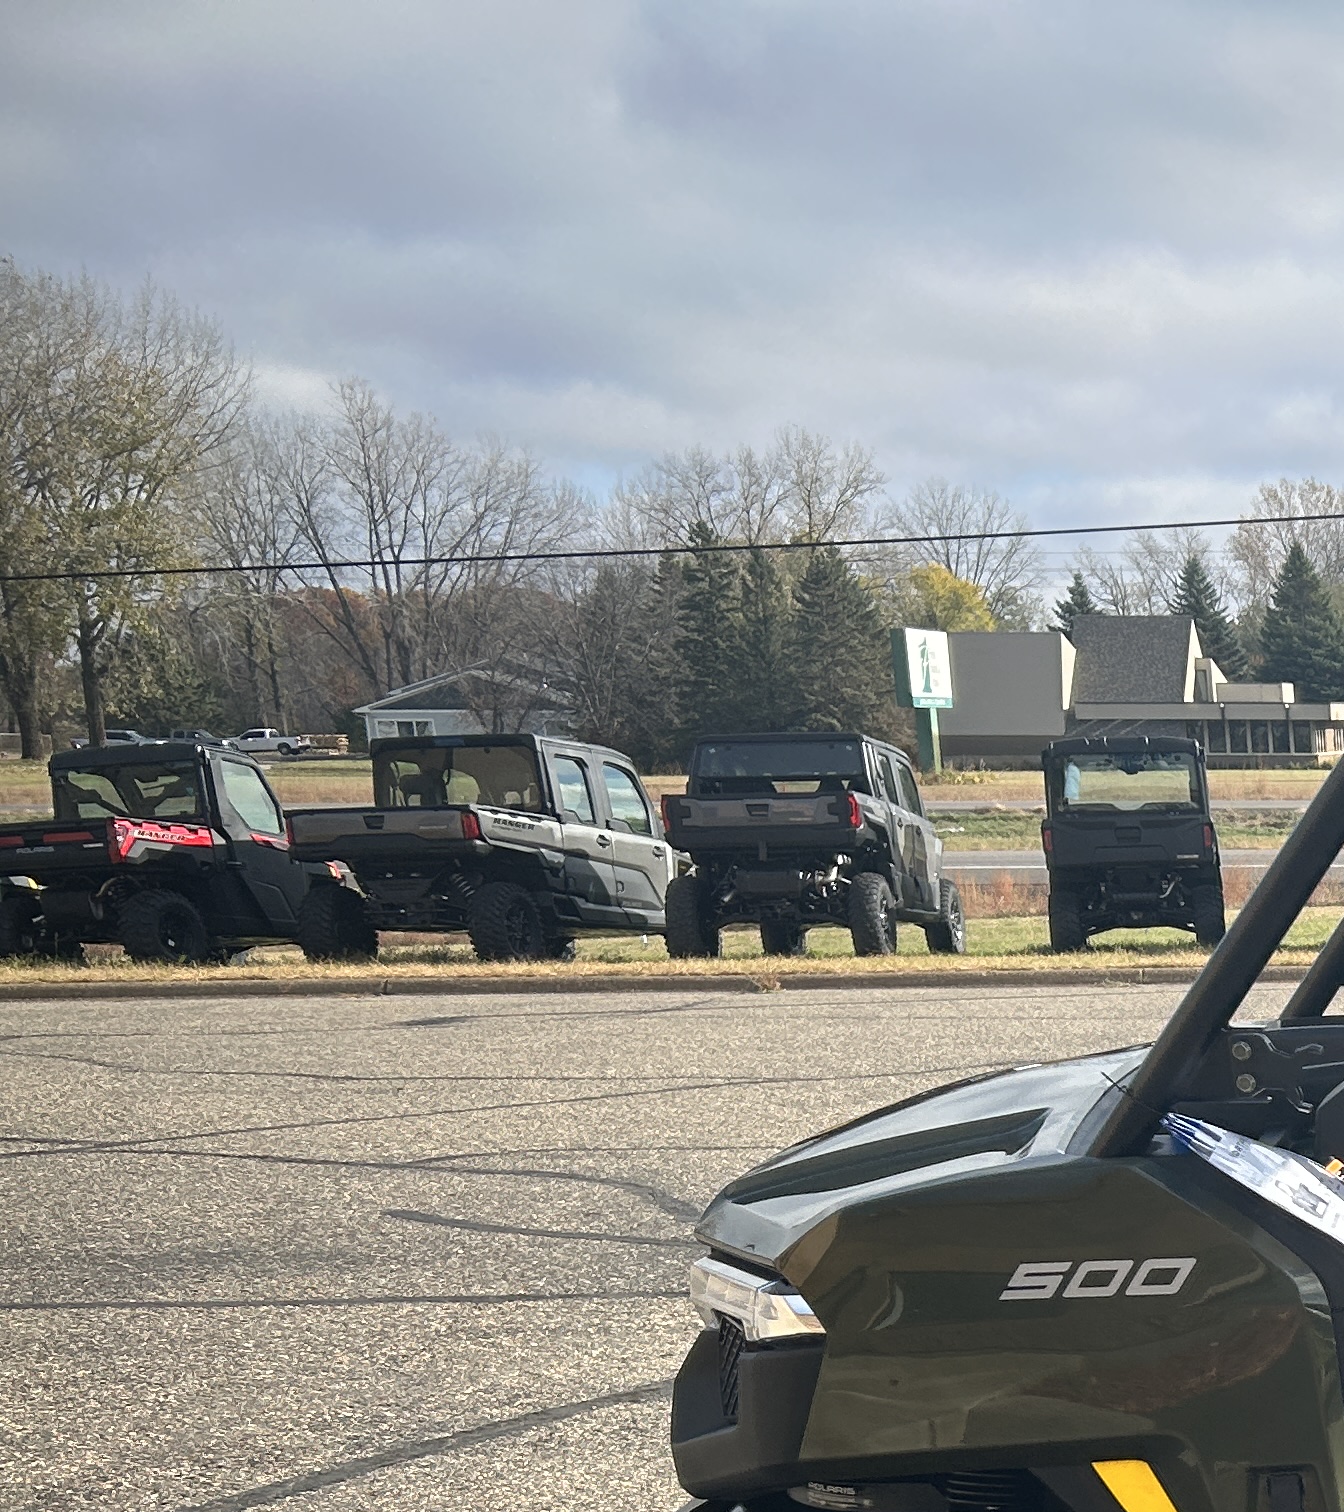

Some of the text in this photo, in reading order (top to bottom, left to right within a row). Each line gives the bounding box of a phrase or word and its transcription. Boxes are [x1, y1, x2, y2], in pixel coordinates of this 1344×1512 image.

[493, 818, 536, 831] RANGER
[999, 1257, 1197, 1300] 500
[807, 1481, 857, 1495] POLARIS
